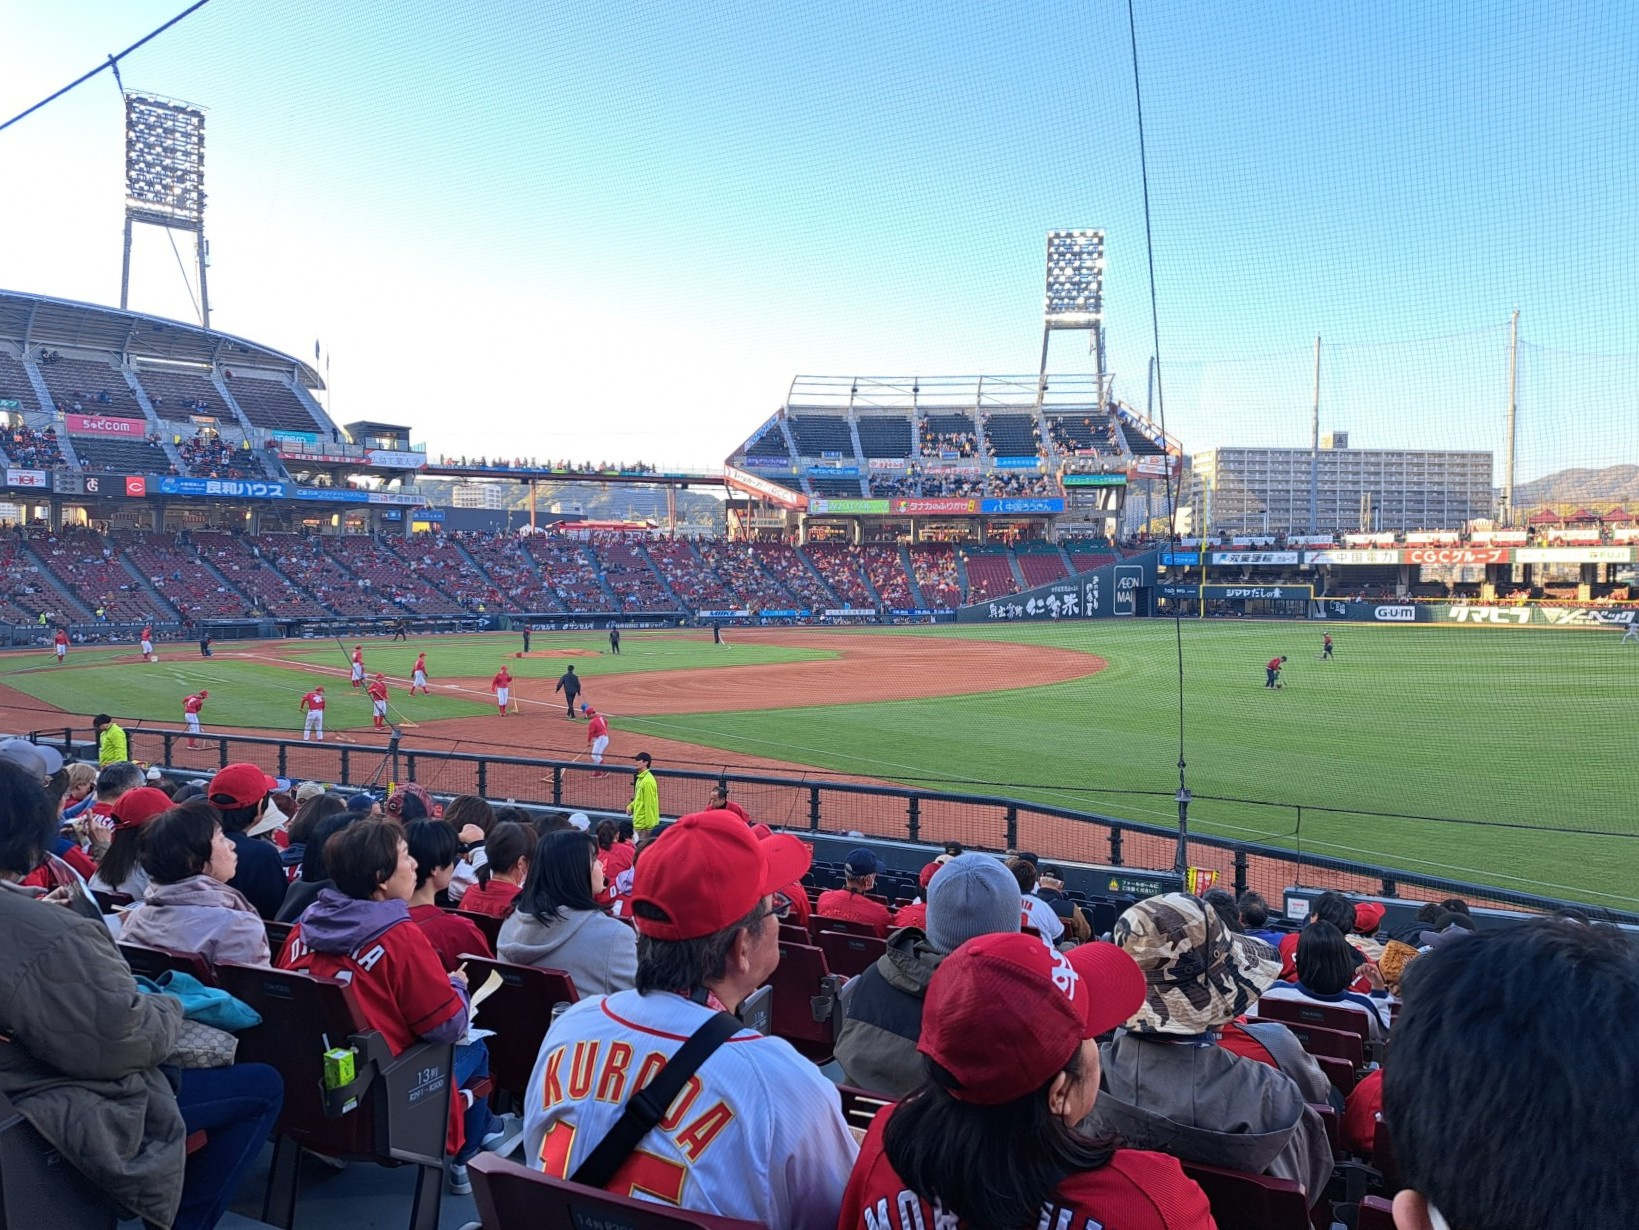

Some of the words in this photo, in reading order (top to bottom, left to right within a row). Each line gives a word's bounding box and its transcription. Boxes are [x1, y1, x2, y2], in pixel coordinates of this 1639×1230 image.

[205, 480, 284, 497] 良和ハウス
[909, 501, 968, 511] タナカのふりかけ
[1005, 503, 1051, 512] 中国ろうきん
[1410, 549, 1502, 563] CGCグループ
[1225, 587, 1283, 598] シマヤだしの素
[1448, 606, 1531, 623] クマヒラ
